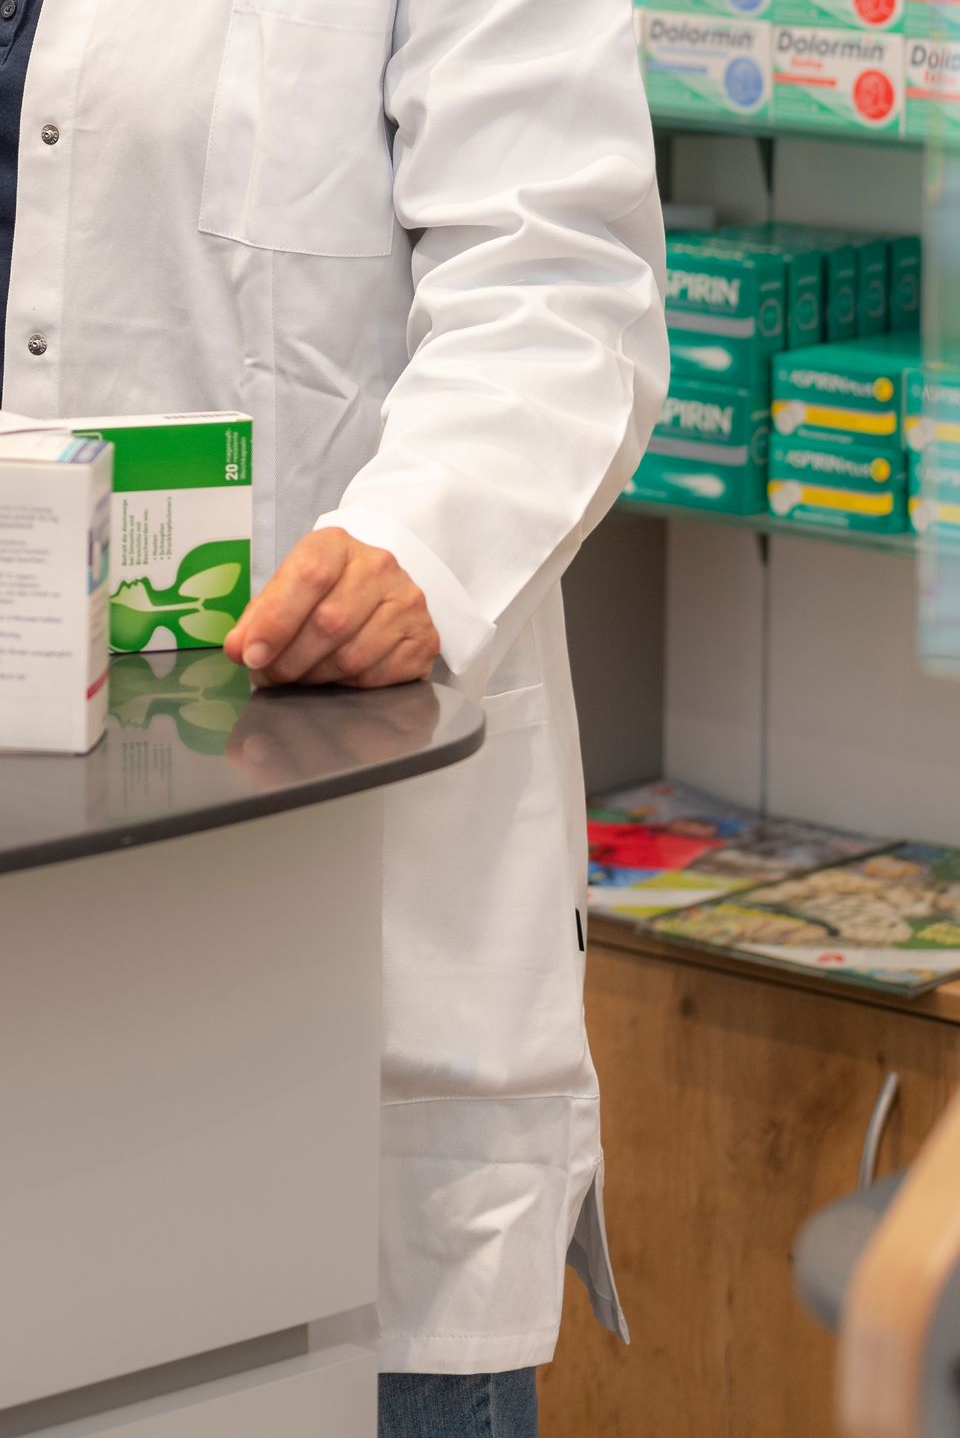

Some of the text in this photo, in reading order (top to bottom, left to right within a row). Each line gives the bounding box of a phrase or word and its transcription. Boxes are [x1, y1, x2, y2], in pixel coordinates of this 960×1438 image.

[649, 19, 755, 49] Dolormin
[777, 29, 885, 63] Dolormin
[225, 464, 239, 481] 20
